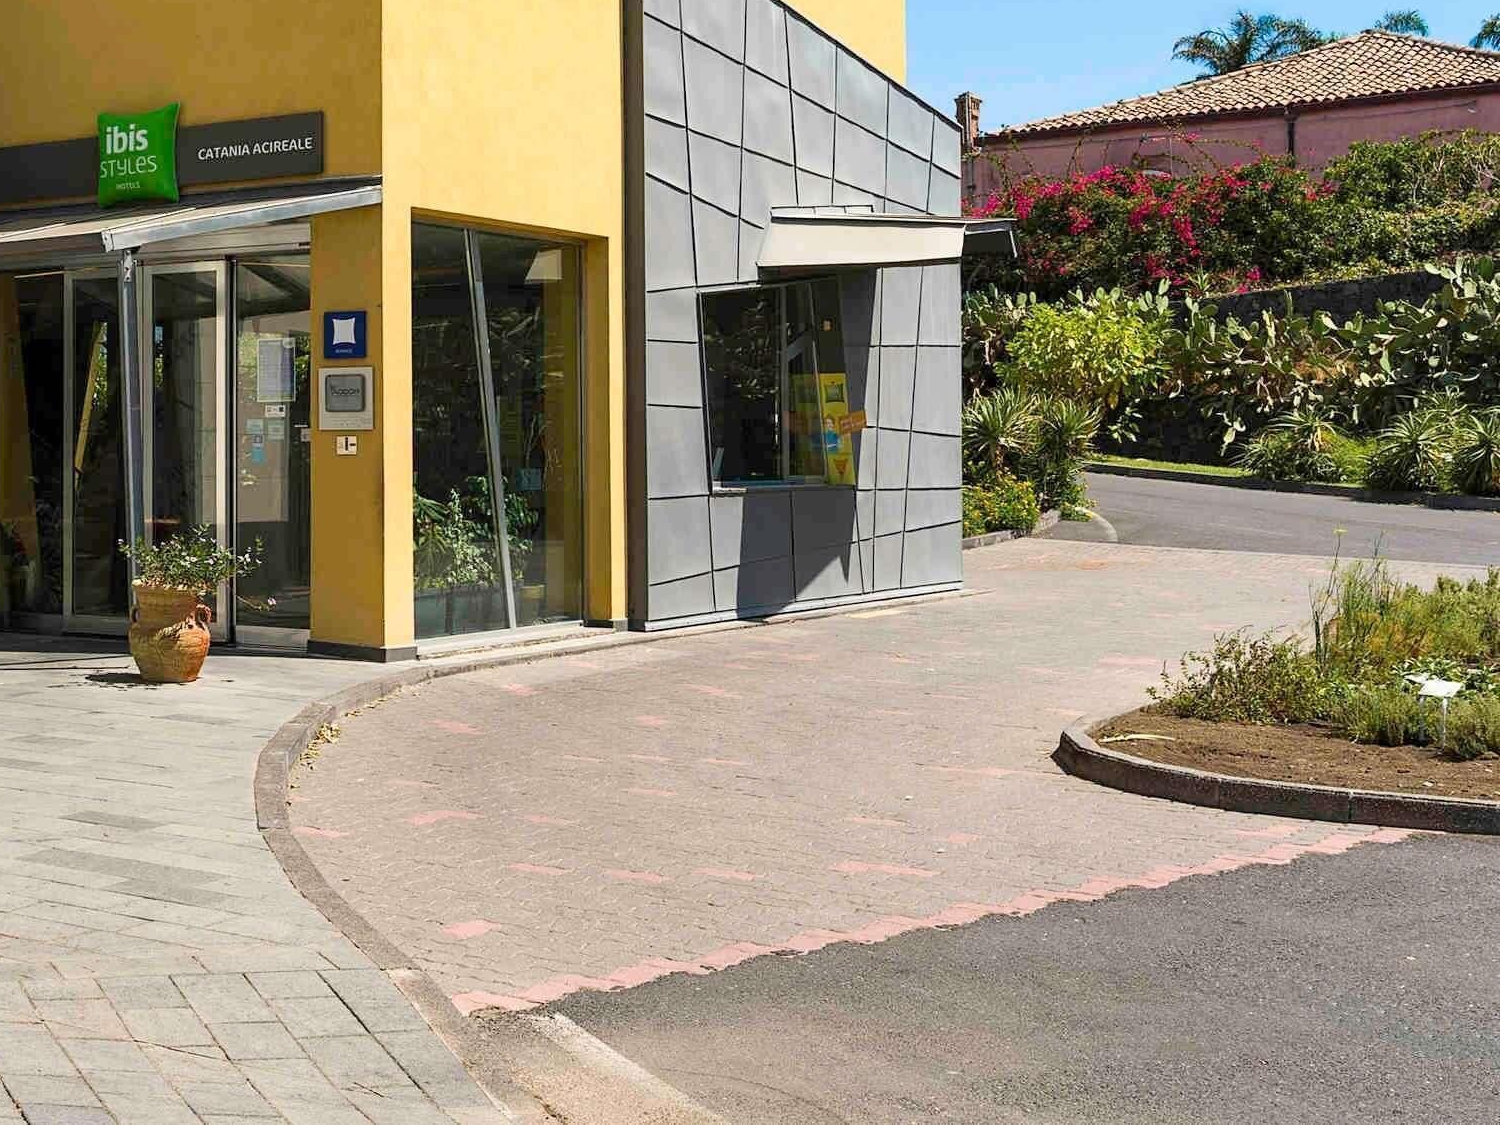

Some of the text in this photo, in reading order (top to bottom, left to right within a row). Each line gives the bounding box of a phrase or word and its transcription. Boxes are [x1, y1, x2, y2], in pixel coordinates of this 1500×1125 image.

[105, 123, 149, 154] ibis
[198, 137, 313, 161] CATANIA ACIREALE
